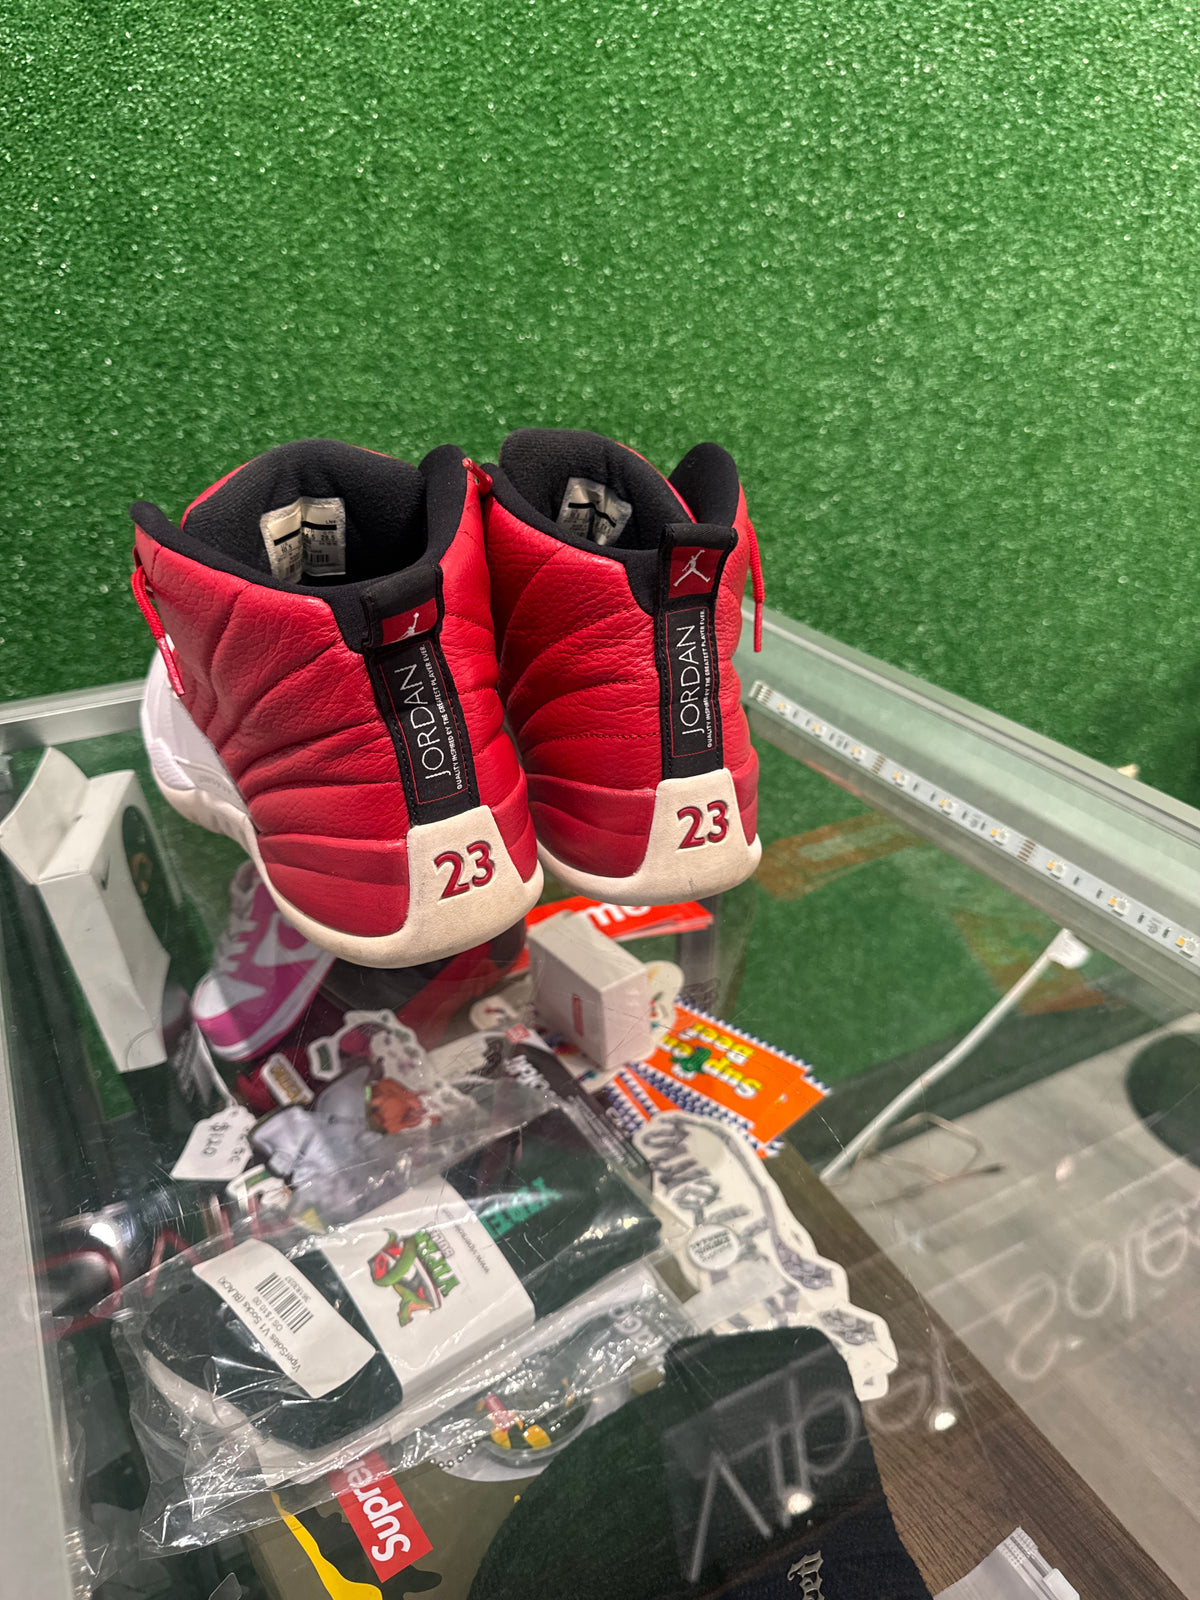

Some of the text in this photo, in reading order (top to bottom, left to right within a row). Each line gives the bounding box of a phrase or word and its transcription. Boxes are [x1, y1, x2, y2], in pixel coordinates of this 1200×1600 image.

[426, 662, 437, 685] PLAYER
[702, 648, 710, 675] GREATEST
[676, 625, 705, 735] JORDAN
[434, 688, 446, 712] GREATEST
[394, 664, 452, 779] JORDAN
[442, 714, 450, 724] THE
[445, 726, 452, 735] BY
[449, 736, 457, 761] INSPIRED
[454, 763, 463, 789] QUALITY
[676, 800, 730, 850] 23
[433, 840, 496, 900] 23
[252, 1296, 272, 1318] $10.00
[217, 1276, 301, 1372] ViperSoles V1 Socks (BLACK)
[272, 1318, 283, 1331] OS
